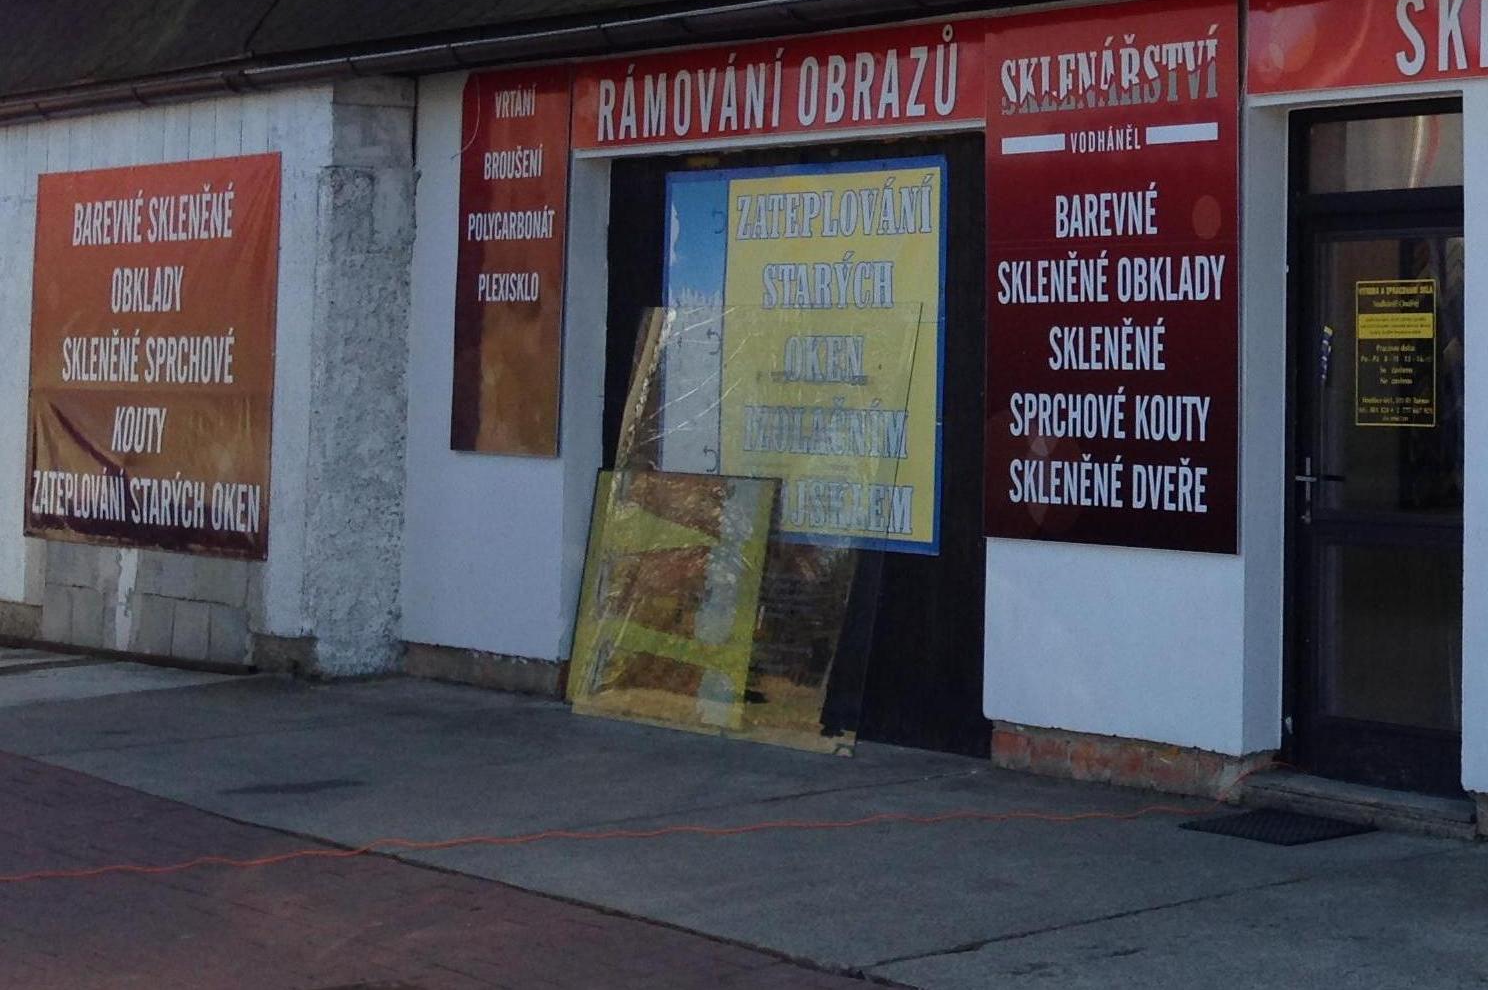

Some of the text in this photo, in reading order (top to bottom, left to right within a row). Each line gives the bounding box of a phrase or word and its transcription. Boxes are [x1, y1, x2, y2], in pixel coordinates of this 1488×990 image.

[596, 24, 959, 142] RÁMOVÁNÍ OBRAZŮ
[1001, 24, 1219, 115] SKLENÁŘSTVÍ
[494, 83, 536, 119] VRTÁNÍ
[483, 143, 543, 181] BROUŠENÍ
[1070, 122, 1141, 154] VODHÁNĚL
[72, 182, 234, 247] BAREVNÉ SKLENĚNÉ
[467, 203, 555, 242] POLYCARBONÁT
[734, 176, 933, 241] ZATEPLOVÁNÍ
[1055, 182, 1158, 238] BAREVNÉ
[110, 265, 184, 314] OBKLADY
[477, 272, 539, 302] PLEXISKLO
[761, 250, 894, 310] STARÝCH
[997, 250, 1226, 304] SKLENĚNÉ OBKLADY
[62, 327, 234, 384] SKLENĚNÉ SPRCHOVÉ
[784, 334, 866, 384] OKEN
[1048, 317, 1166, 371] SKLENĚNÉ
[111, 405, 167, 455] KOUTY
[1009, 386, 1211, 442] SPRCHOVÉ KOUTY
[31, 466, 261, 533] ZATEPLOVÁNÍ STARÝCH OKEN
[1009, 454, 1208, 513] SKLENĚNÉ DVEŘE
